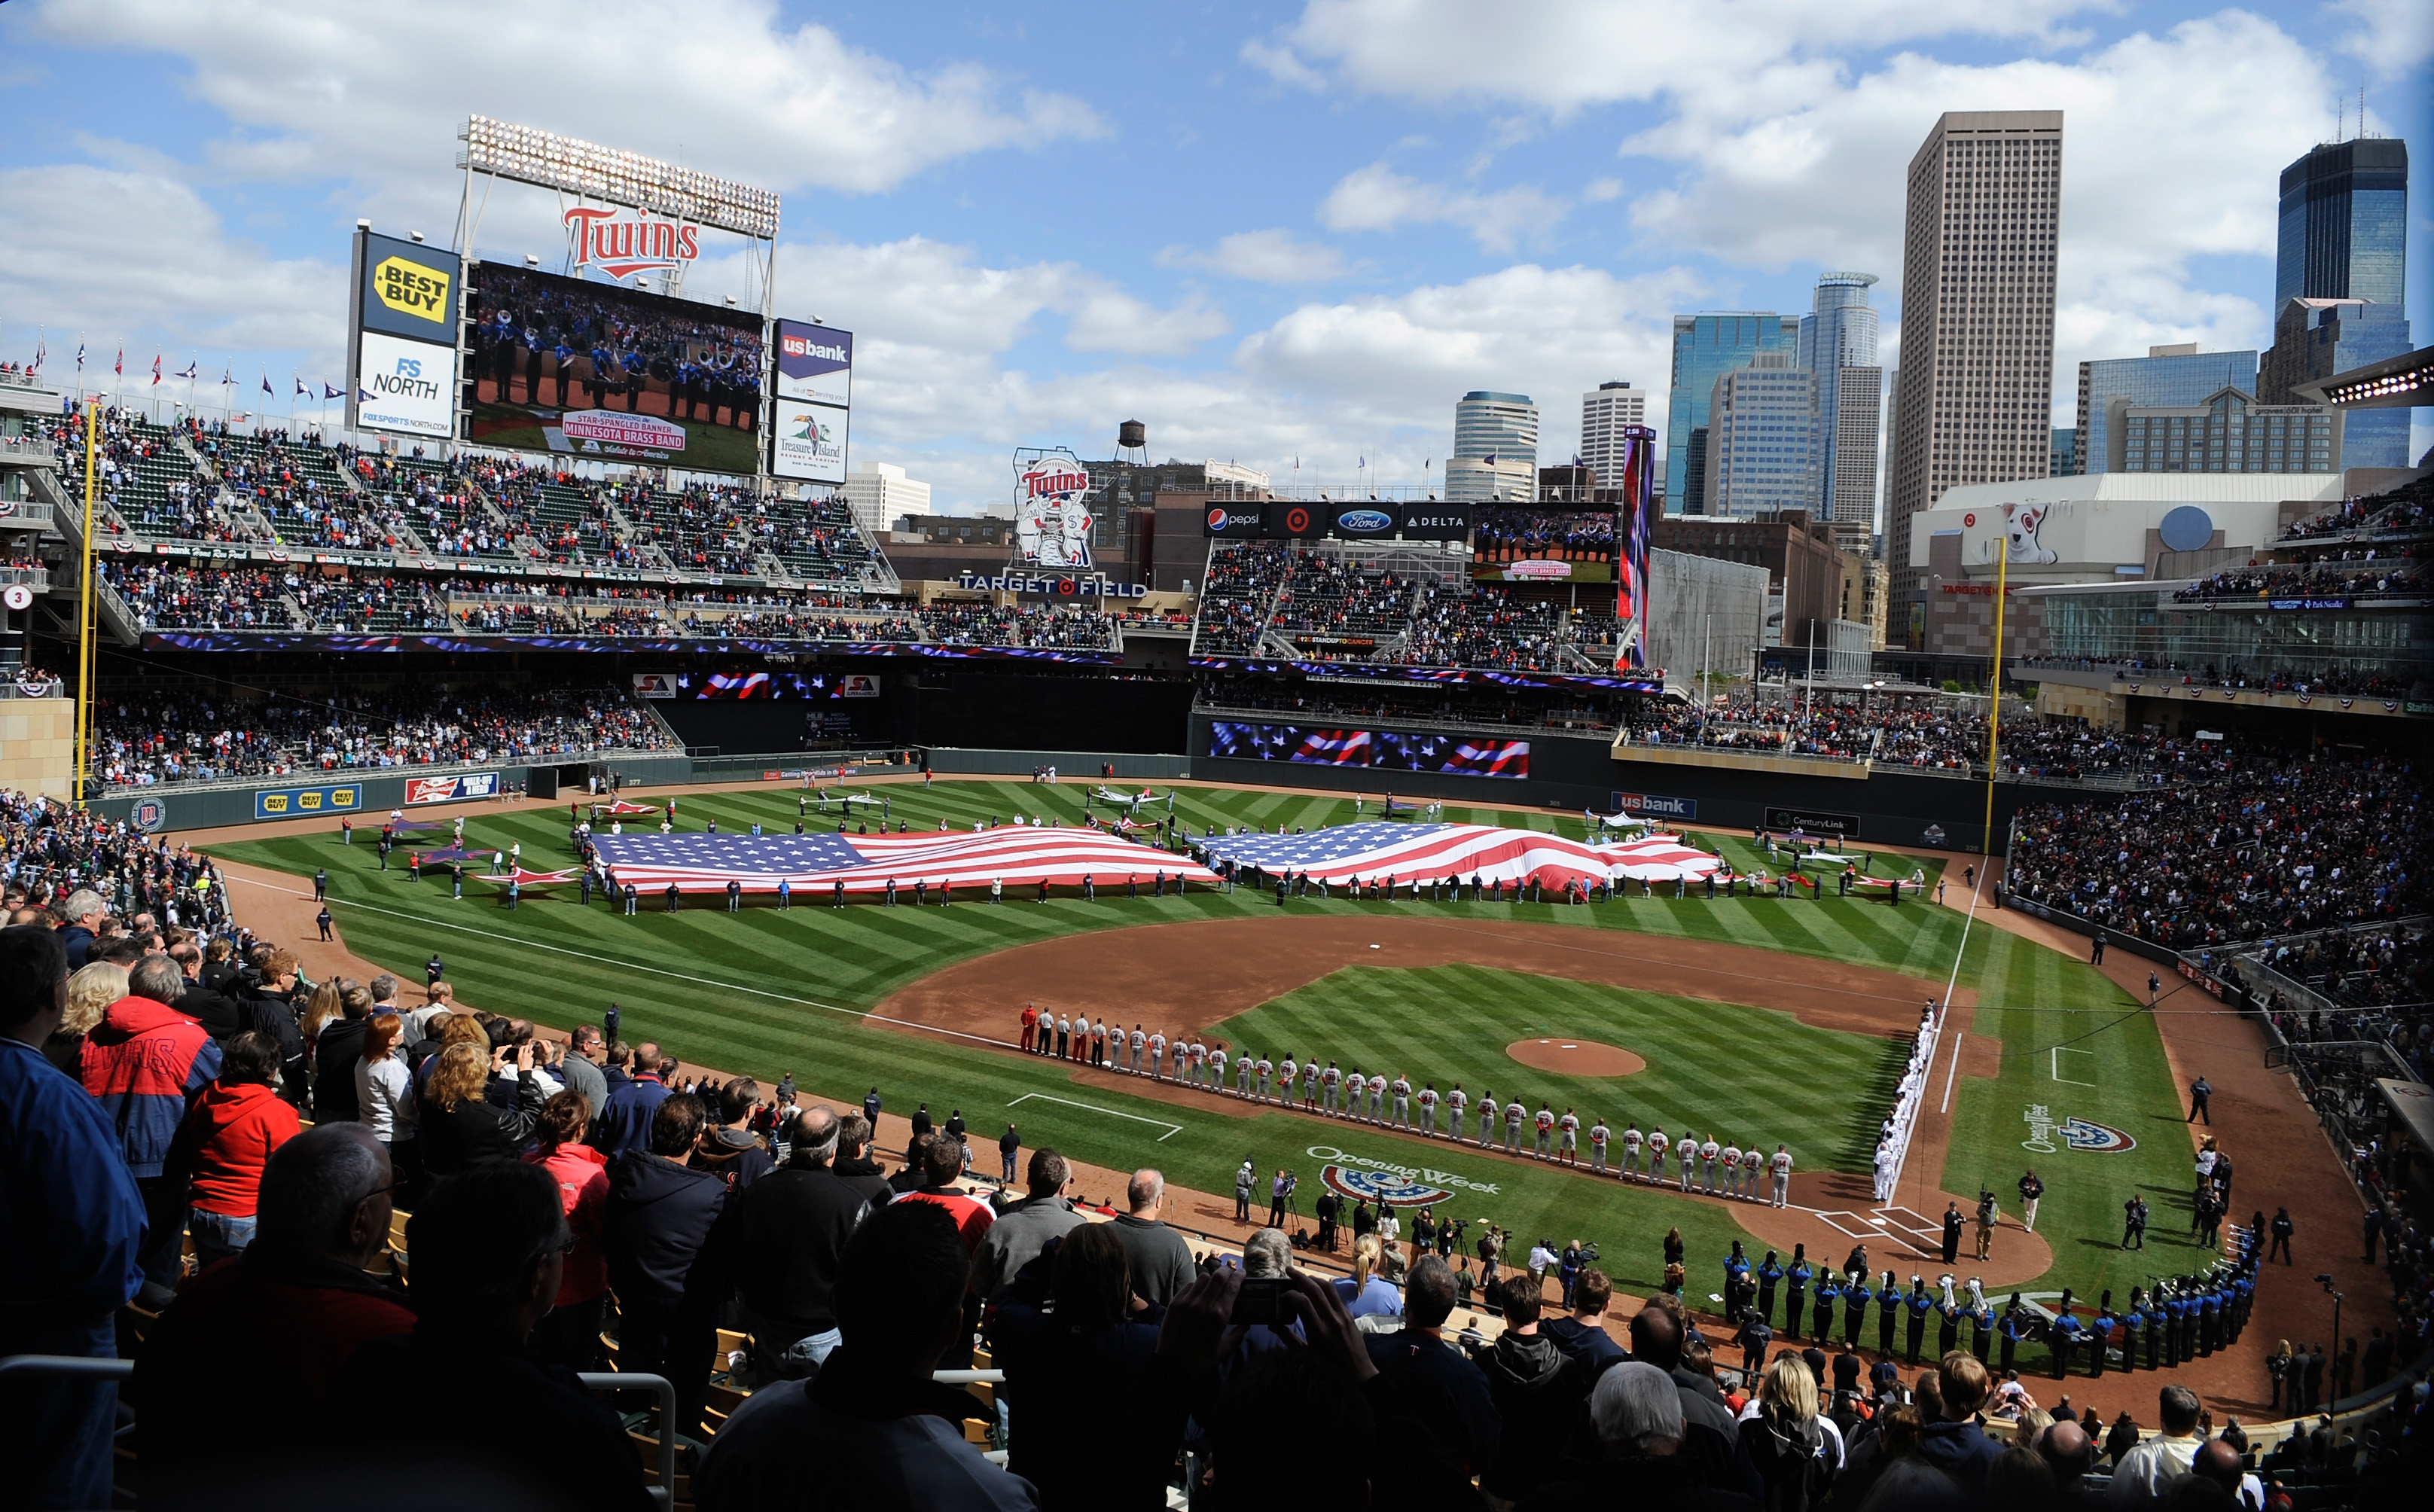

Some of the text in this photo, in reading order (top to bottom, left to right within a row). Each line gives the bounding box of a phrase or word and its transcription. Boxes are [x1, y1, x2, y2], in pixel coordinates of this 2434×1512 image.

[564, 208, 699, 264] Twins
[385, 264, 446, 297] BEST
[386, 282, 440, 312] BUY
[395, 358, 422, 378] FS
[374, 373, 438, 400] NORTH
[578, 415, 672, 434] STAR-SPANGLED BANNER
[599, 411, 640, 422] PERFORMING
[566, 422, 682, 447] MINNESOTA BRASS BAND
[604, 445, 628, 455] Salute
[636, 450, 670, 460] America
[780, 437, 840, 458] Treasure Island
[1022, 468, 1087, 499] Twins
[1228, 514, 1258, 526] pepsi
[1348, 513, 1381, 528] Ford
[1422, 517, 1464, 526] DELTA
[959, 575, 1148, 598] TARGET FIELD
[1942, 585, 1982, 595] TARGET
[14, 592, 23, 603] 3
[1793, 816, 1844, 829] CenturyLink
[1306, 1146, 1502, 1195] Opening Week
